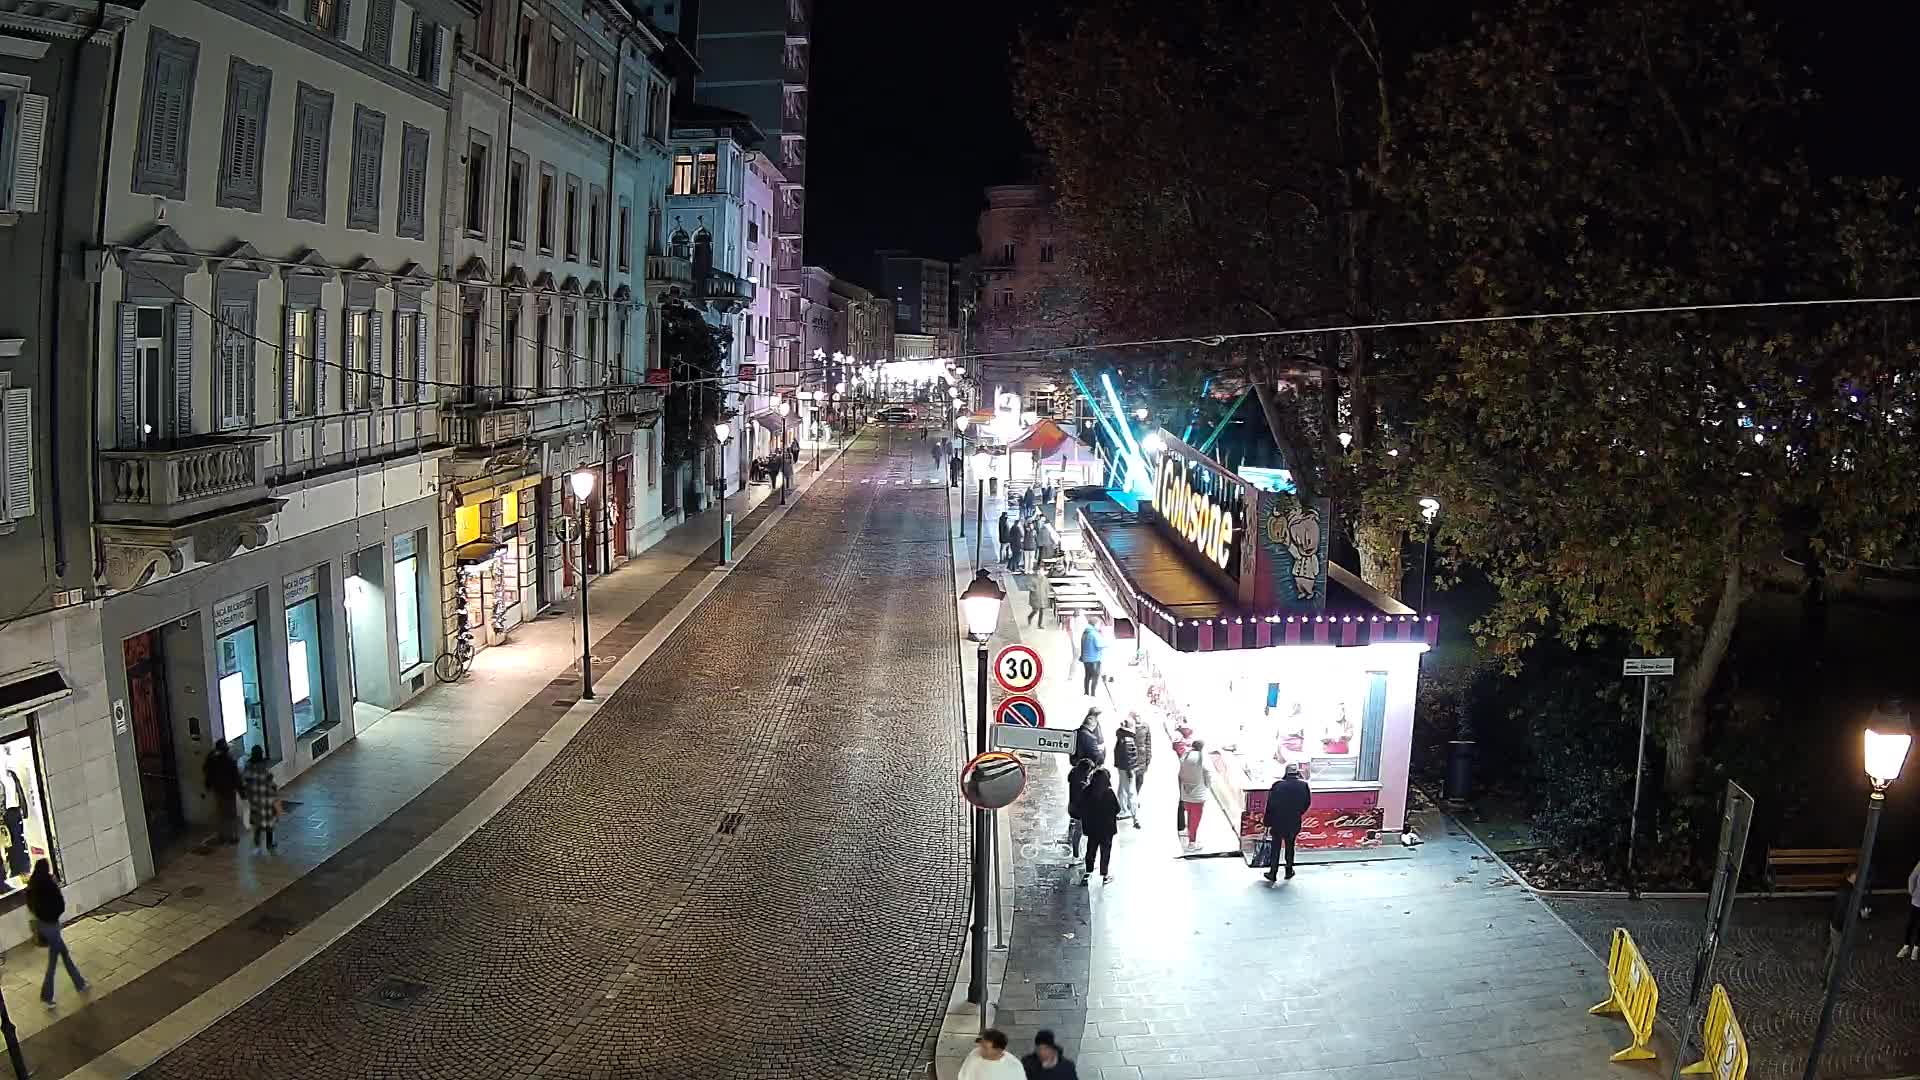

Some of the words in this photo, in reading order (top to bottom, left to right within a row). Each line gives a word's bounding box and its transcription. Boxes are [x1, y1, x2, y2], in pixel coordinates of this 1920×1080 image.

[1161, 455, 1233, 569] Golosone
[1005, 657, 1033, 680] 30
[1038, 737, 1070, 749] Dante
